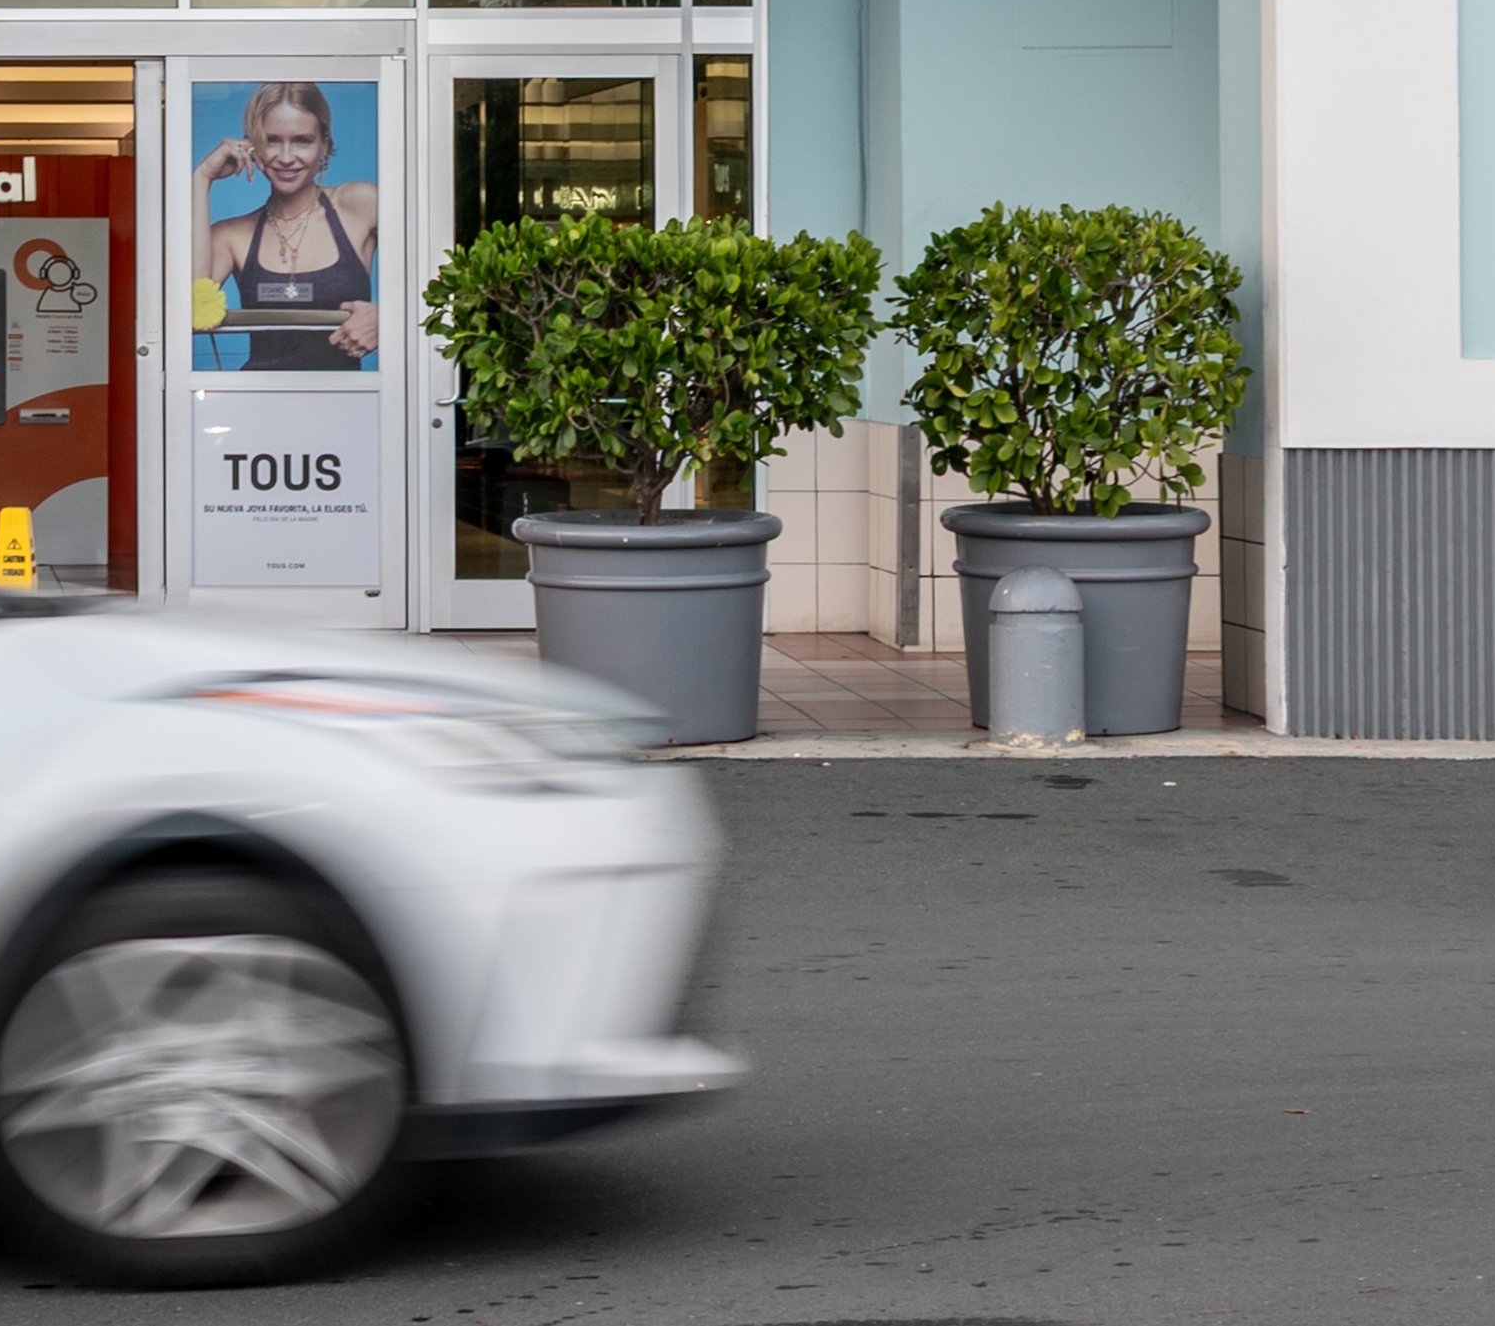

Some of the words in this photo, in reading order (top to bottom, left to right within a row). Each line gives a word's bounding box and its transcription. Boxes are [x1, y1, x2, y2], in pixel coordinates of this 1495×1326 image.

[223, 453, 341, 491] TOUS
[204, 505, 215, 513] SU
[217, 505, 244, 513] NUEVA
[246, 505, 267, 513] JOYA
[312, 505, 322, 513] LA
[324, 505, 353, 513] ELIGES
